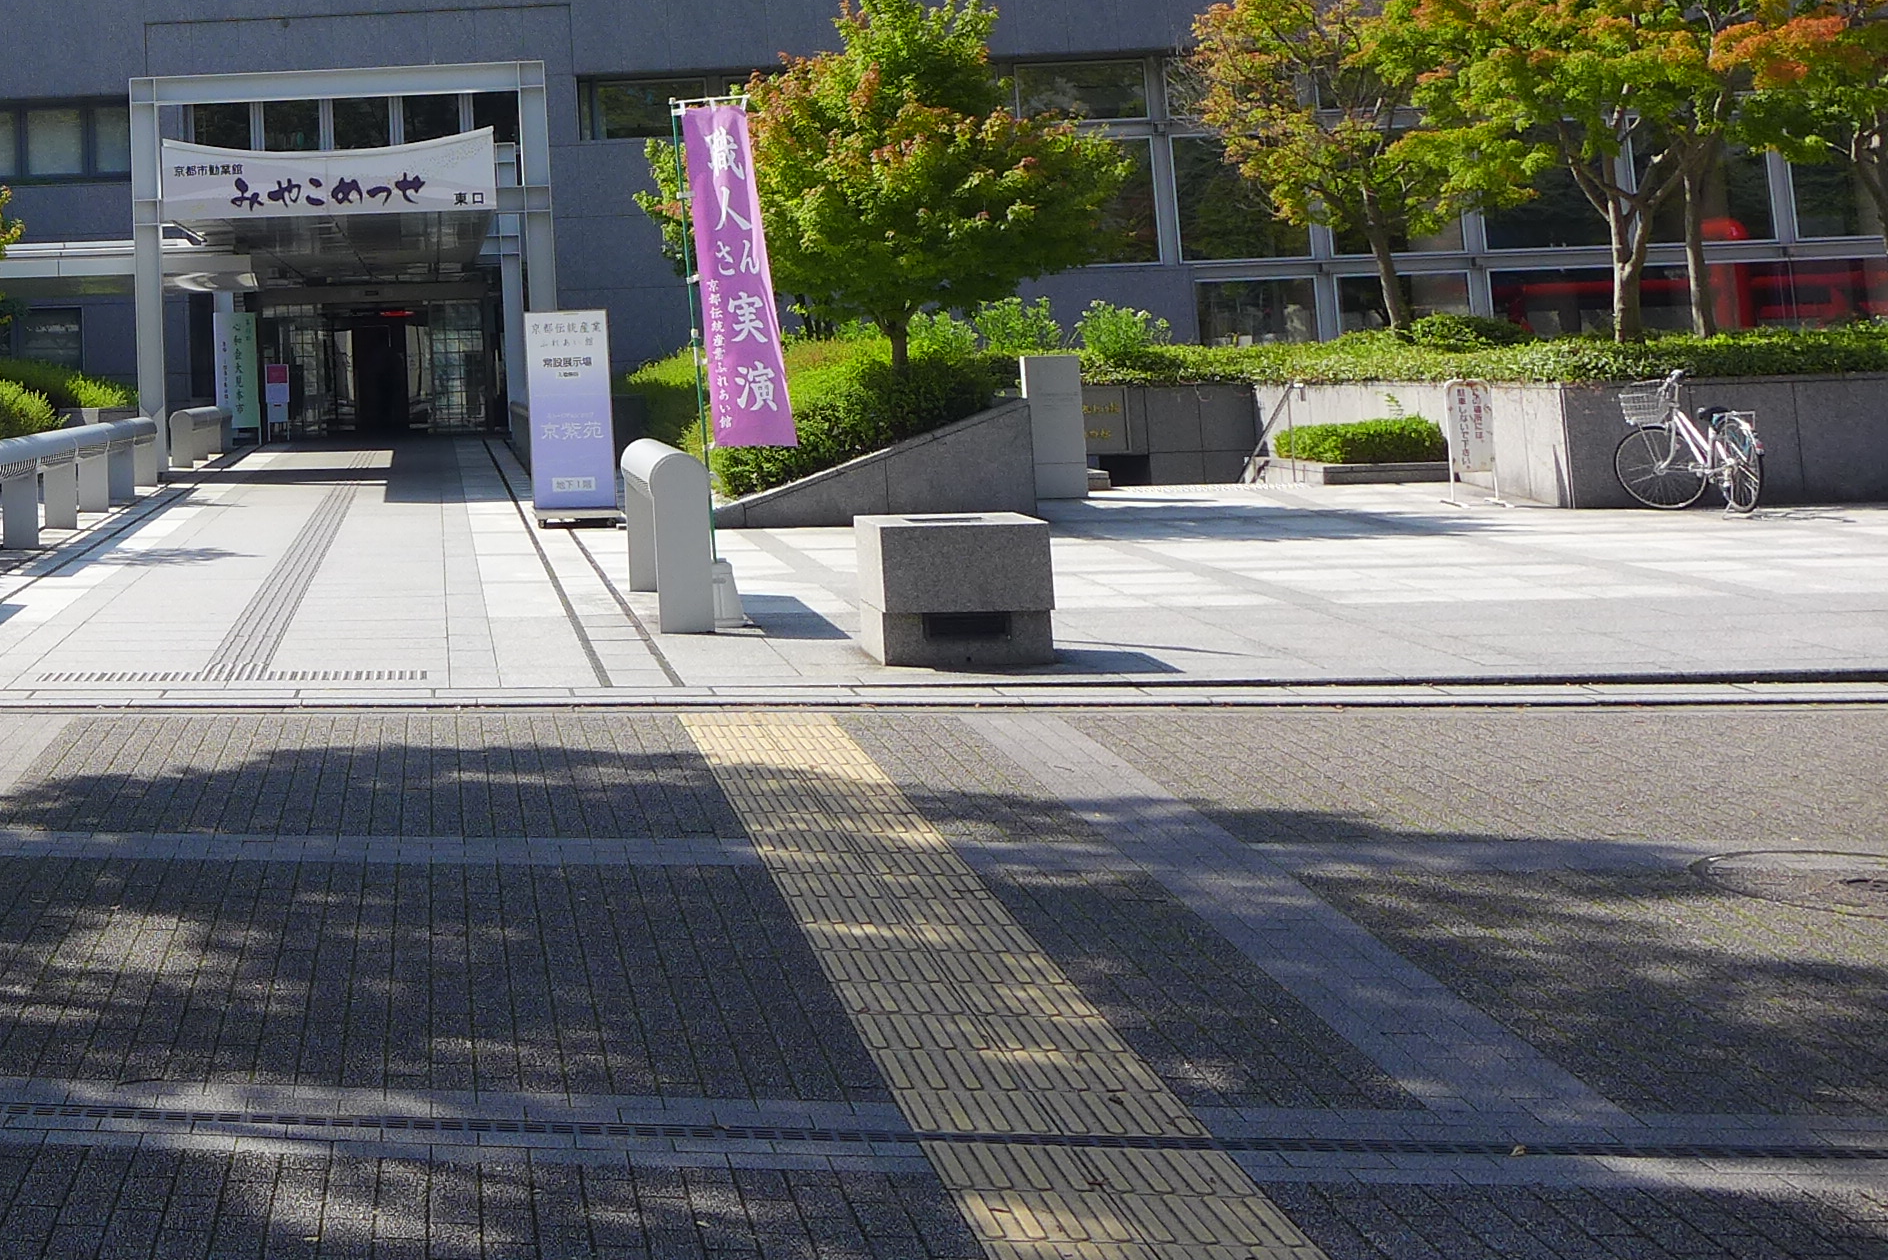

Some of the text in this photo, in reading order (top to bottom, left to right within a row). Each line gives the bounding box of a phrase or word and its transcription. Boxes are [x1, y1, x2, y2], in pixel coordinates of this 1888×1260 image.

[174, 163, 244, 177] 京都市勧業館
[230, 172, 426, 212] みやこめっせ
[453, 191, 486, 206] 東口
[704, 125, 779, 412] 職人さん実演
